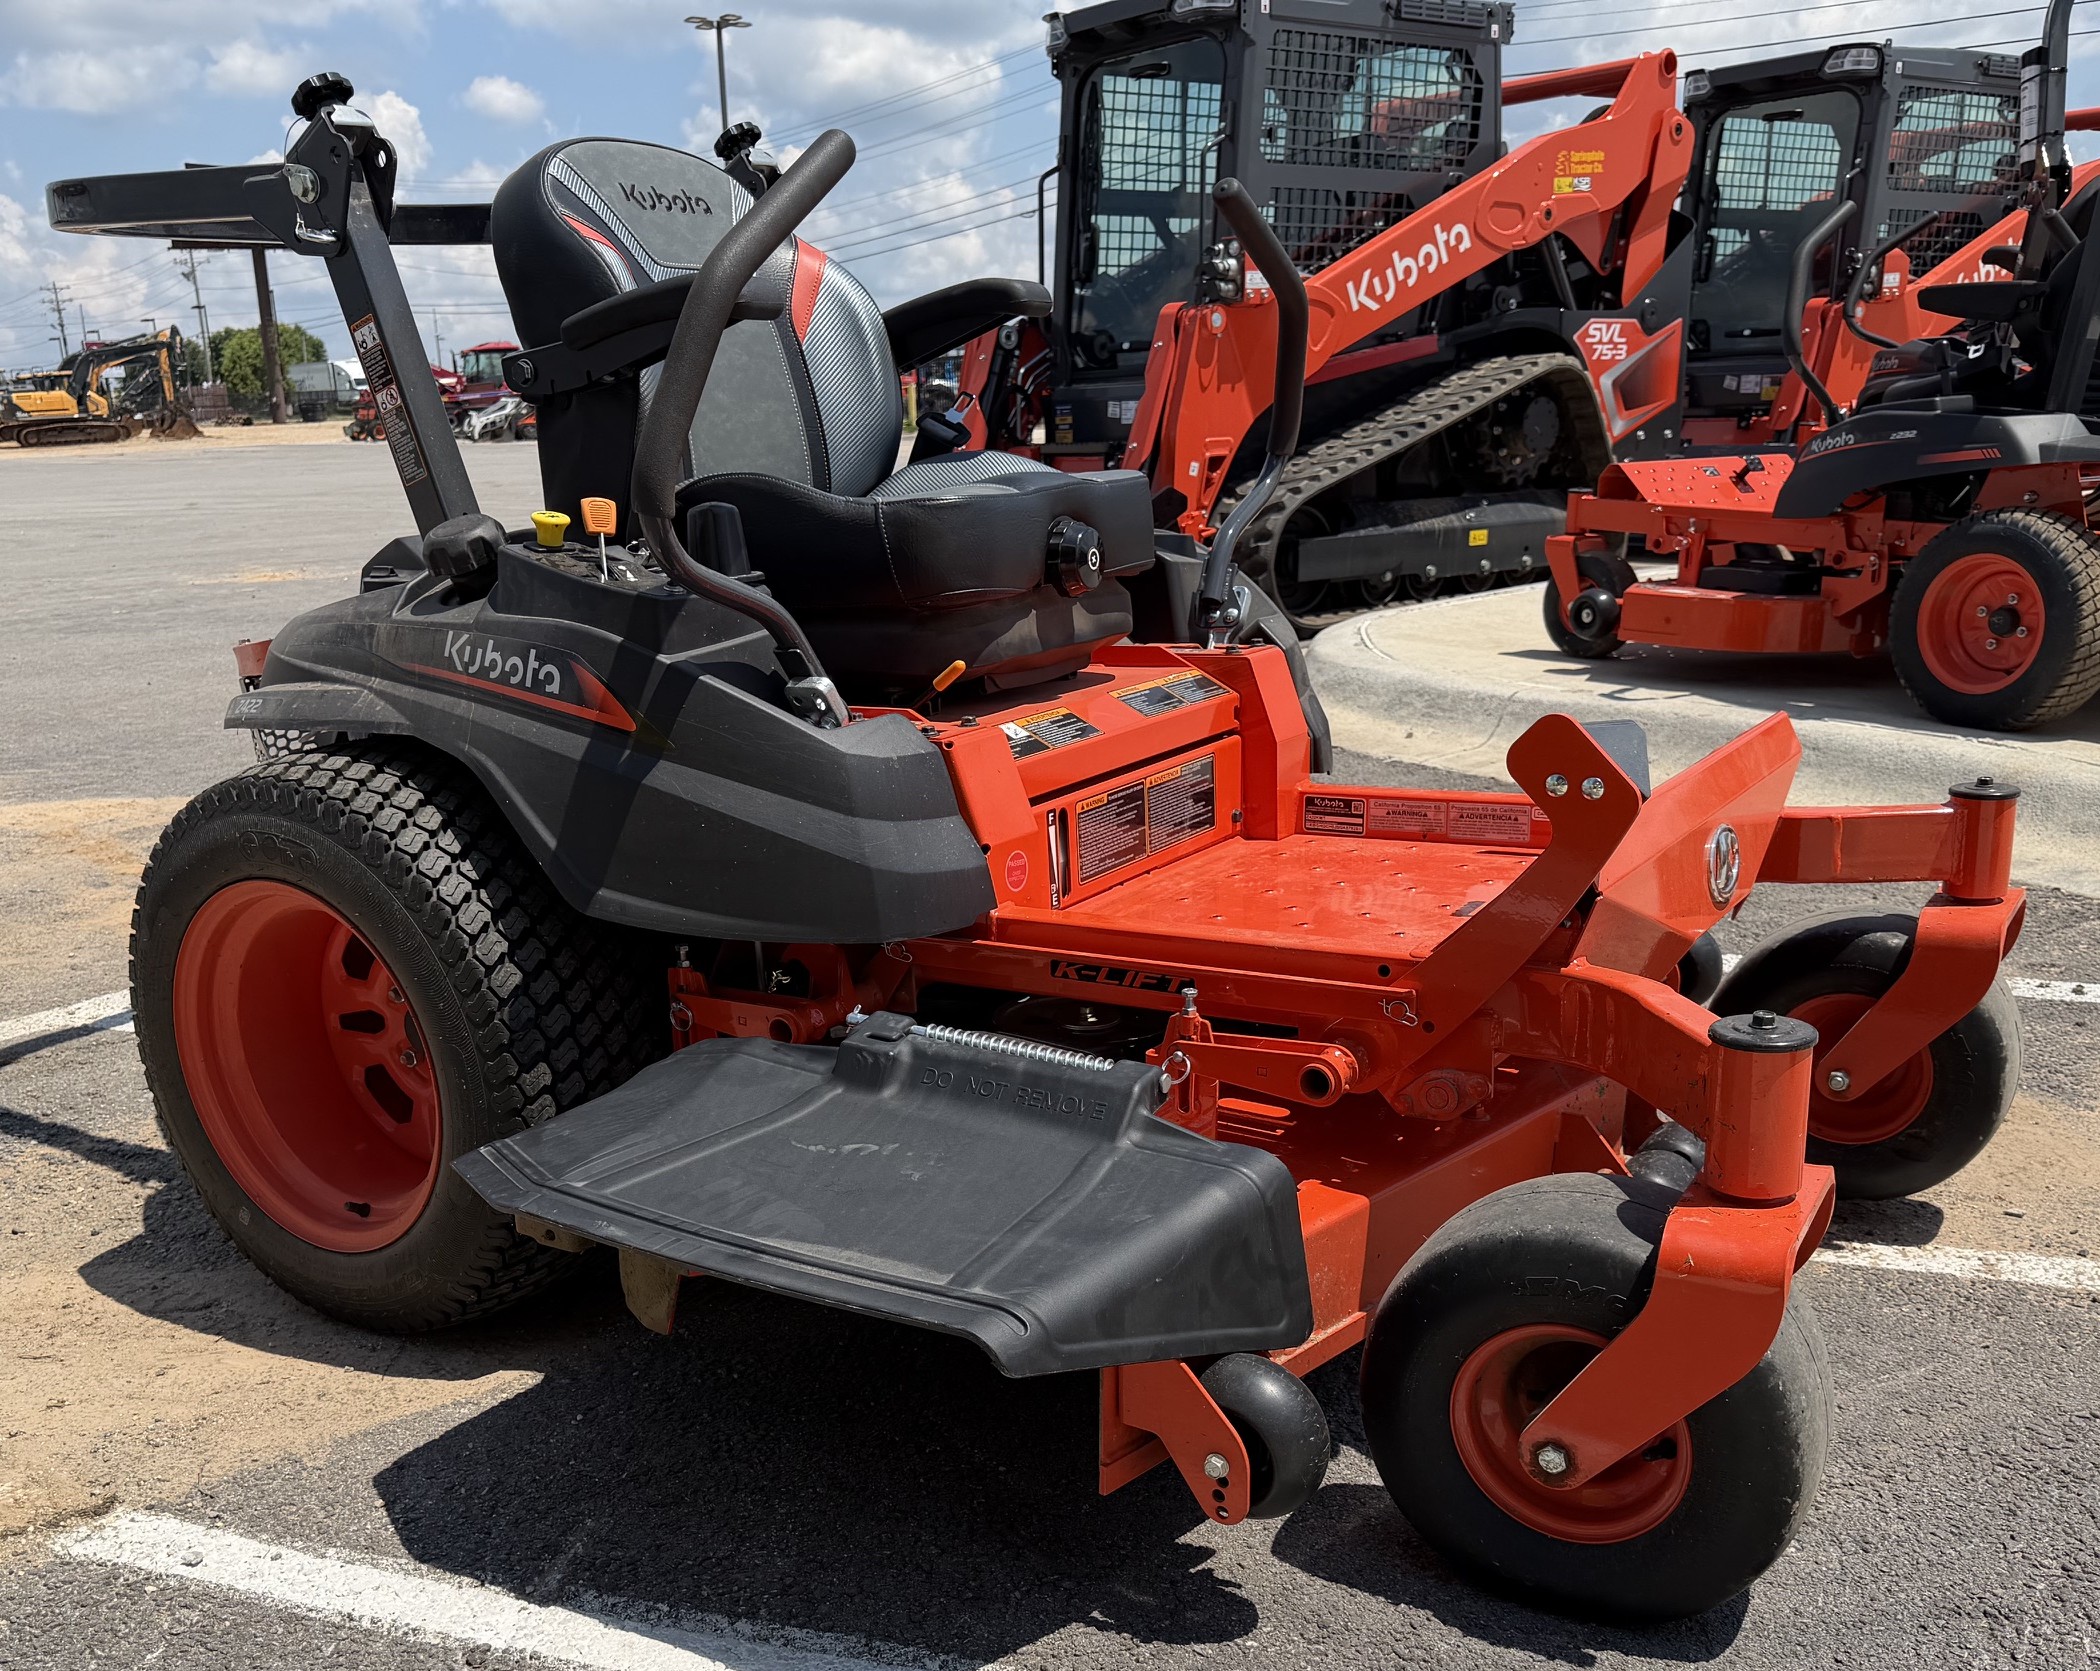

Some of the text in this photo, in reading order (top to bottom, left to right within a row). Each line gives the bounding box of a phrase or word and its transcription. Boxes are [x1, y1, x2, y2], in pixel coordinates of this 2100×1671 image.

[1570, 150, 1605, 162] Springdale
[1570, 162, 1592, 174] Tractor
[617, 182, 713, 215] Kubota
[1346, 222, 1472, 312] Kubota
[1585, 323, 1628, 343] SVL
[1591, 344, 1628, 360] 75-3
[1811, 432, 1855, 452] Kubota
[444, 630, 562, 694] Kubota
[1314, 798, 1344, 807] Kubota
[1048, 812, 1055, 825] F
[1465, 813, 1512, 821] ADVERTENCIA
[1052, 893, 1059, 906] E
[1054, 961, 1190, 993] K-LIFT
[920, 1066, 1109, 1121] DO NOT REMOVE
